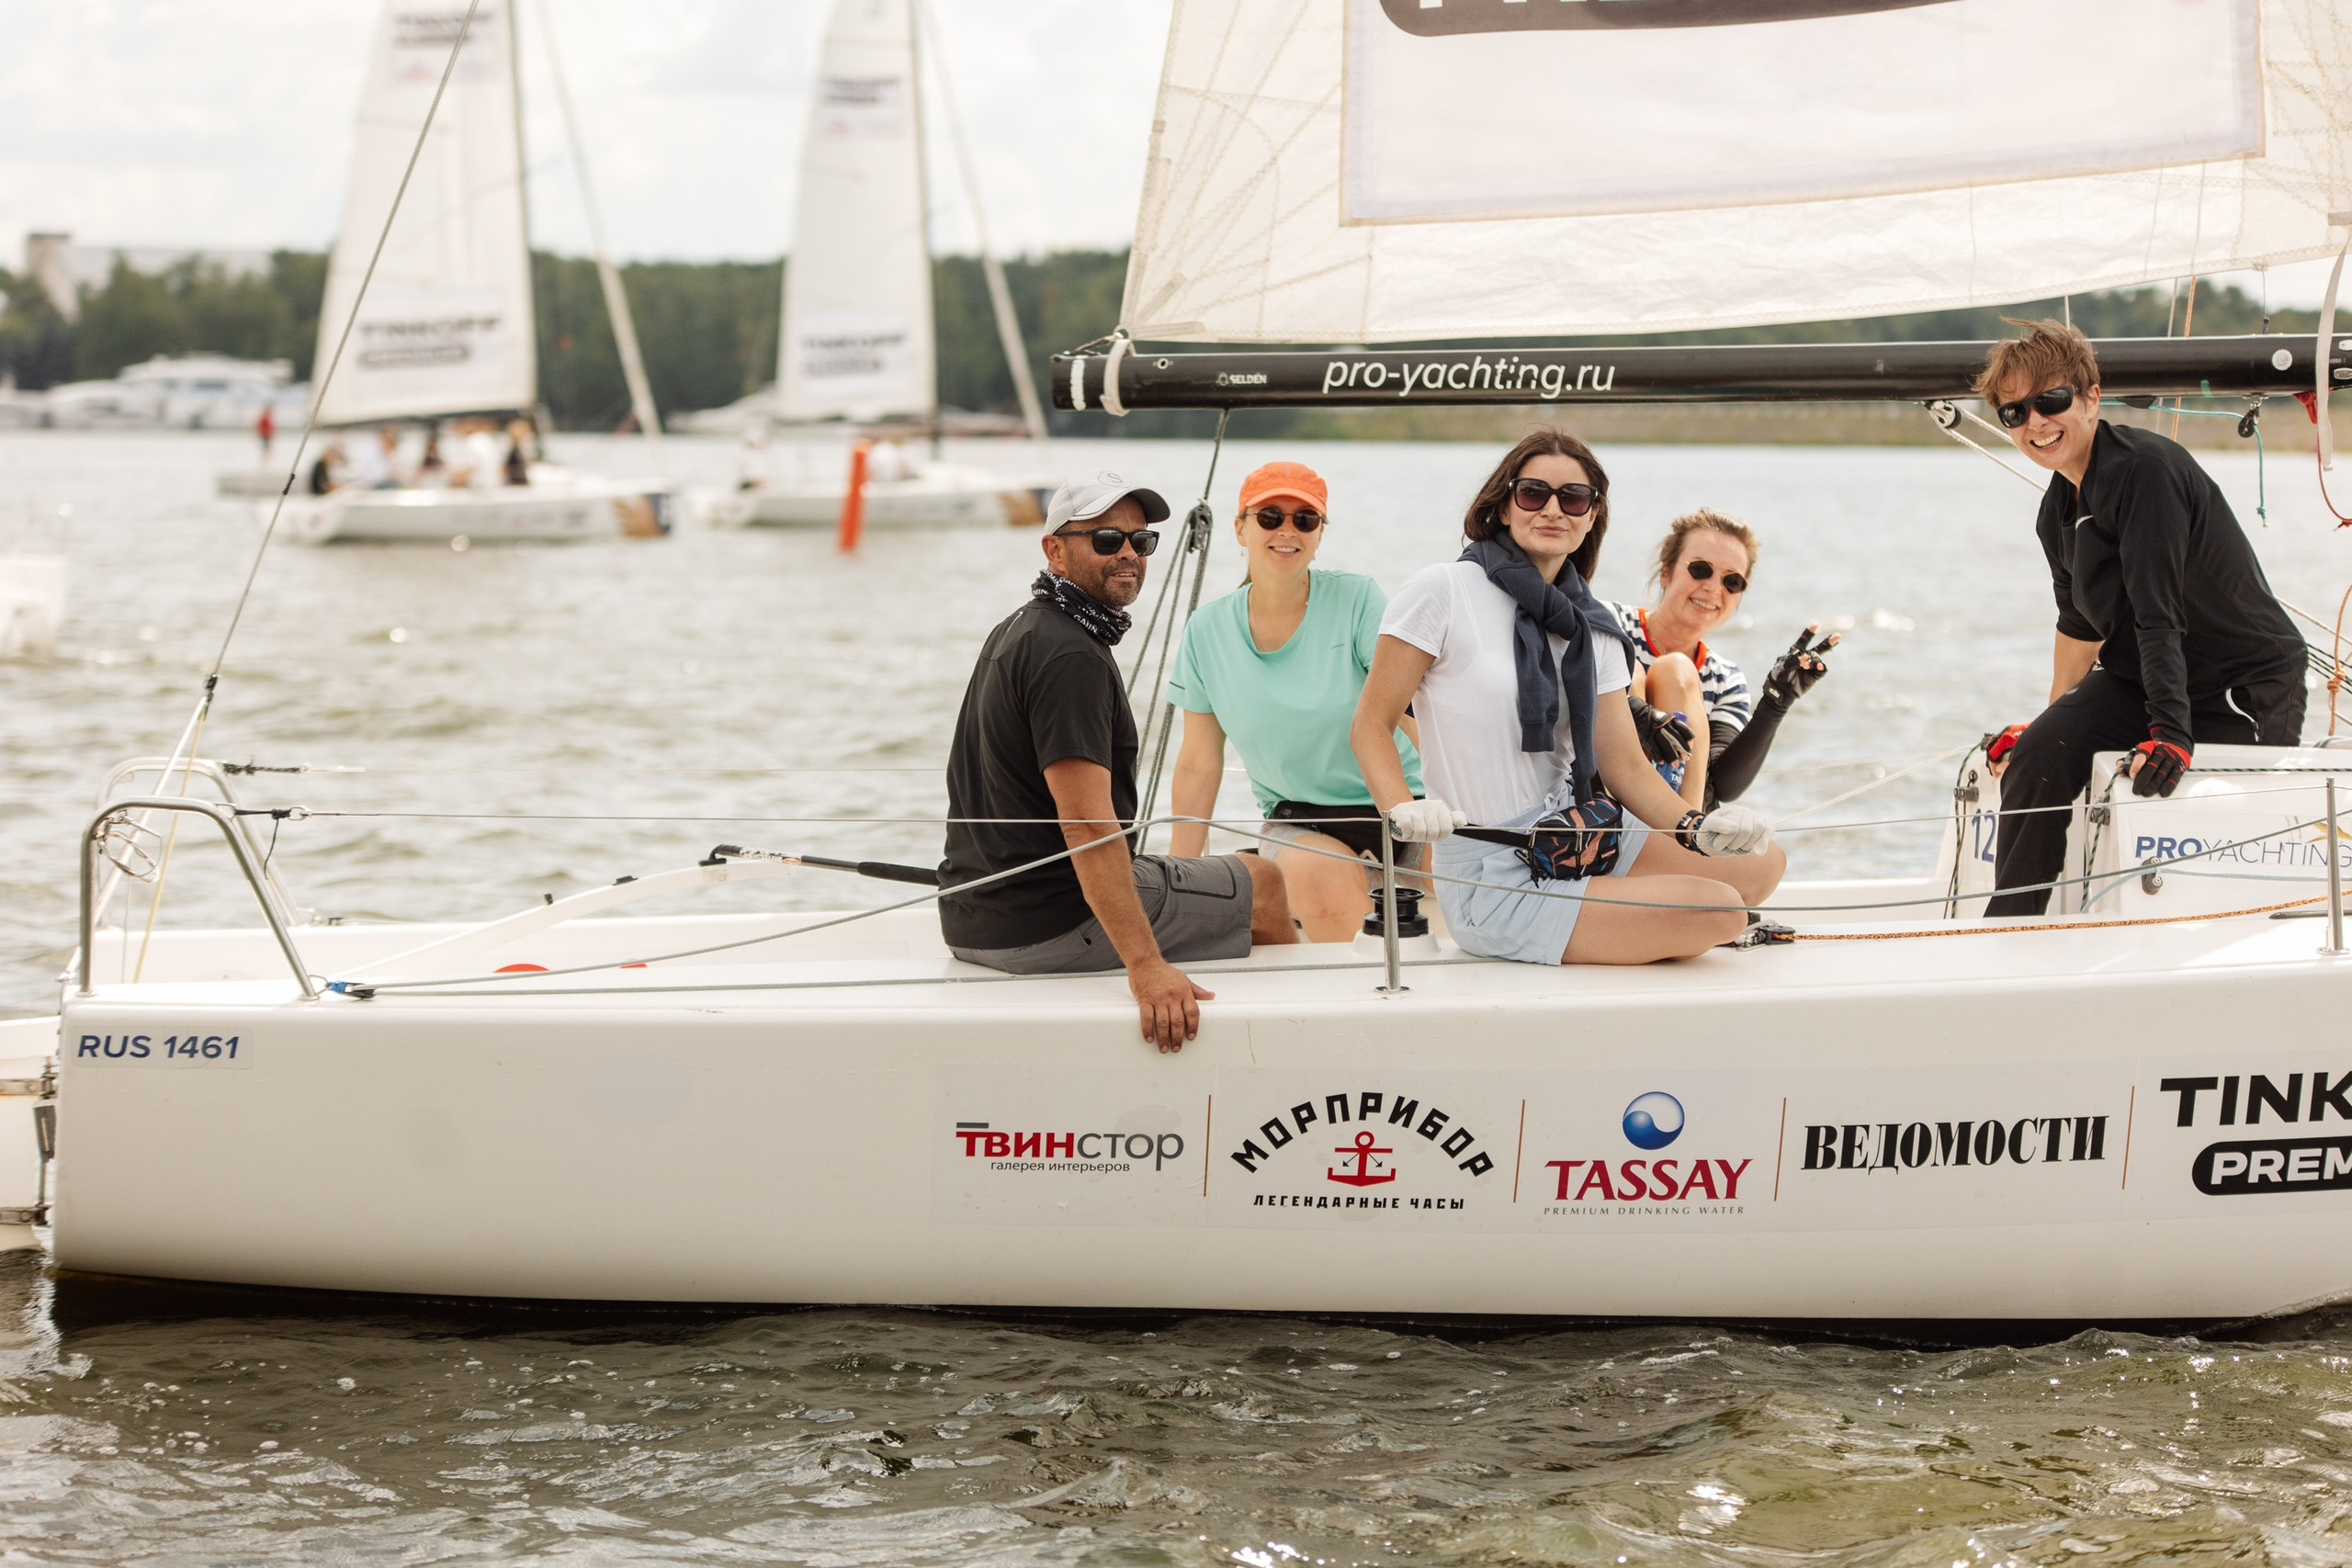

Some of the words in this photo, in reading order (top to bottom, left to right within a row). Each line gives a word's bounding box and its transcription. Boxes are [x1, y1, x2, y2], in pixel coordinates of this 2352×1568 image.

[1322, 355, 1615, 399] pro-yachting.ru
[1972, 808, 1996, 863] 12
[77, 1035, 151, 1059] RUS
[164, 1035, 240, 1059] 1461
[2160, 1071, 2352, 1128] TINK
[1231, 1092, 1494, 1177] МОРПРИБОР
[1801, 1115, 2109, 1176] ВЕДОМОСТИ
[990, 1161, 1045, 1173] галерея
[1048, 1161, 1130, 1174] интерьеров
[1544, 1159, 1754, 1201] TASSAY
[1253, 1195, 1399, 1209] ЛЕГЕНДАРНЫЕ
[1410, 1198, 1464, 1210] ЧАСЫ
[1544, 1207, 1609, 1215] PREMIUM
[1618, 1206, 1690, 1215] DRINKING
[1699, 1206, 1744, 1214] WATER
